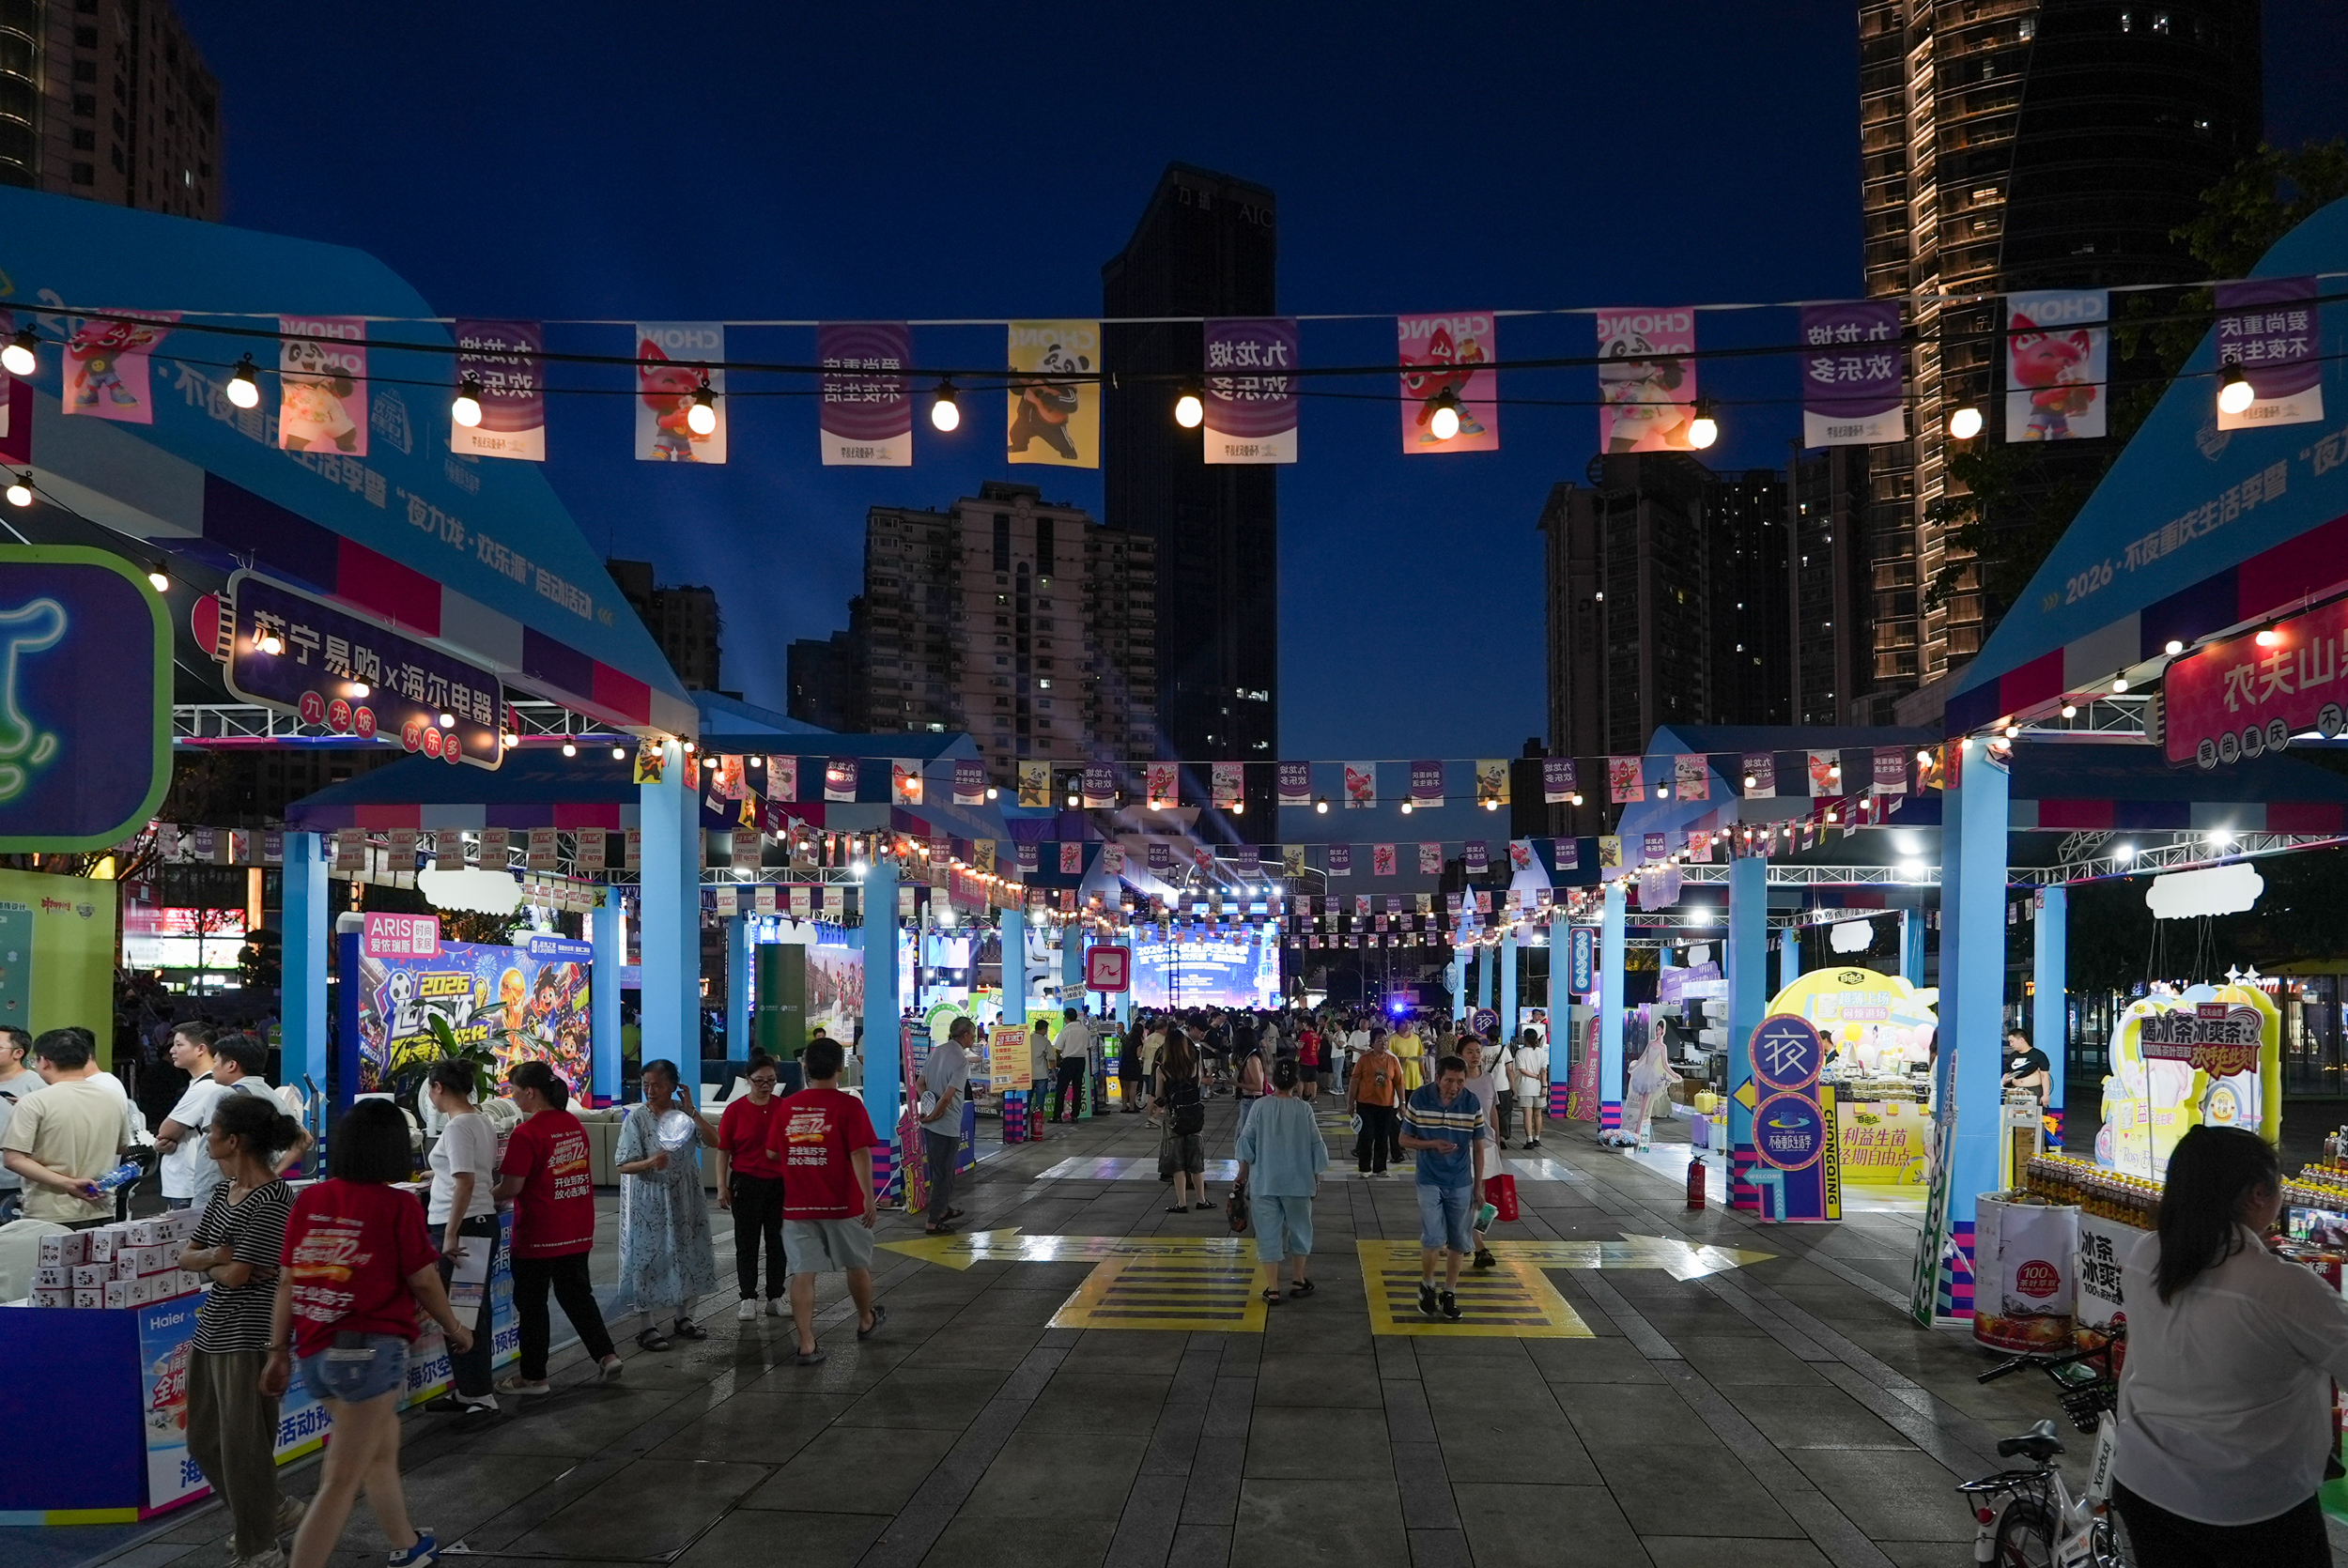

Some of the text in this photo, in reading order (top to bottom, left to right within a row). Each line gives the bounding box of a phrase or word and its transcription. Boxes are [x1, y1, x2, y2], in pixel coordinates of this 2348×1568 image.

[1239, 204, 1274, 228] AIC
[306, 698, 372, 732] 九龙坡
[407, 728, 457, 756] 欢乐多
[2201, 723, 2284, 762] 爱尚重庆
[371, 918, 410, 936] ARIS
[415, 924, 432, 937] 时尚
[371, 939, 410, 953] 爱依瑞斯
[415, 938, 432, 950] 家居
[1576, 932, 1588, 988] 2026
[419, 976, 470, 995] 2026
[1838, 991, 1891, 1006] 超薄上场
[1764, 1028, 1809, 1076] 夜
[2191, 1045, 2254, 1070] 欢呼在此刻
[1769, 1135, 1812, 1150] 不夜重庆生活季
[1823, 1109, 1838, 1205] CHONGQING
[2081, 1230, 2114, 1263] 冰茶
[149, 1312, 185, 1330] Haier
